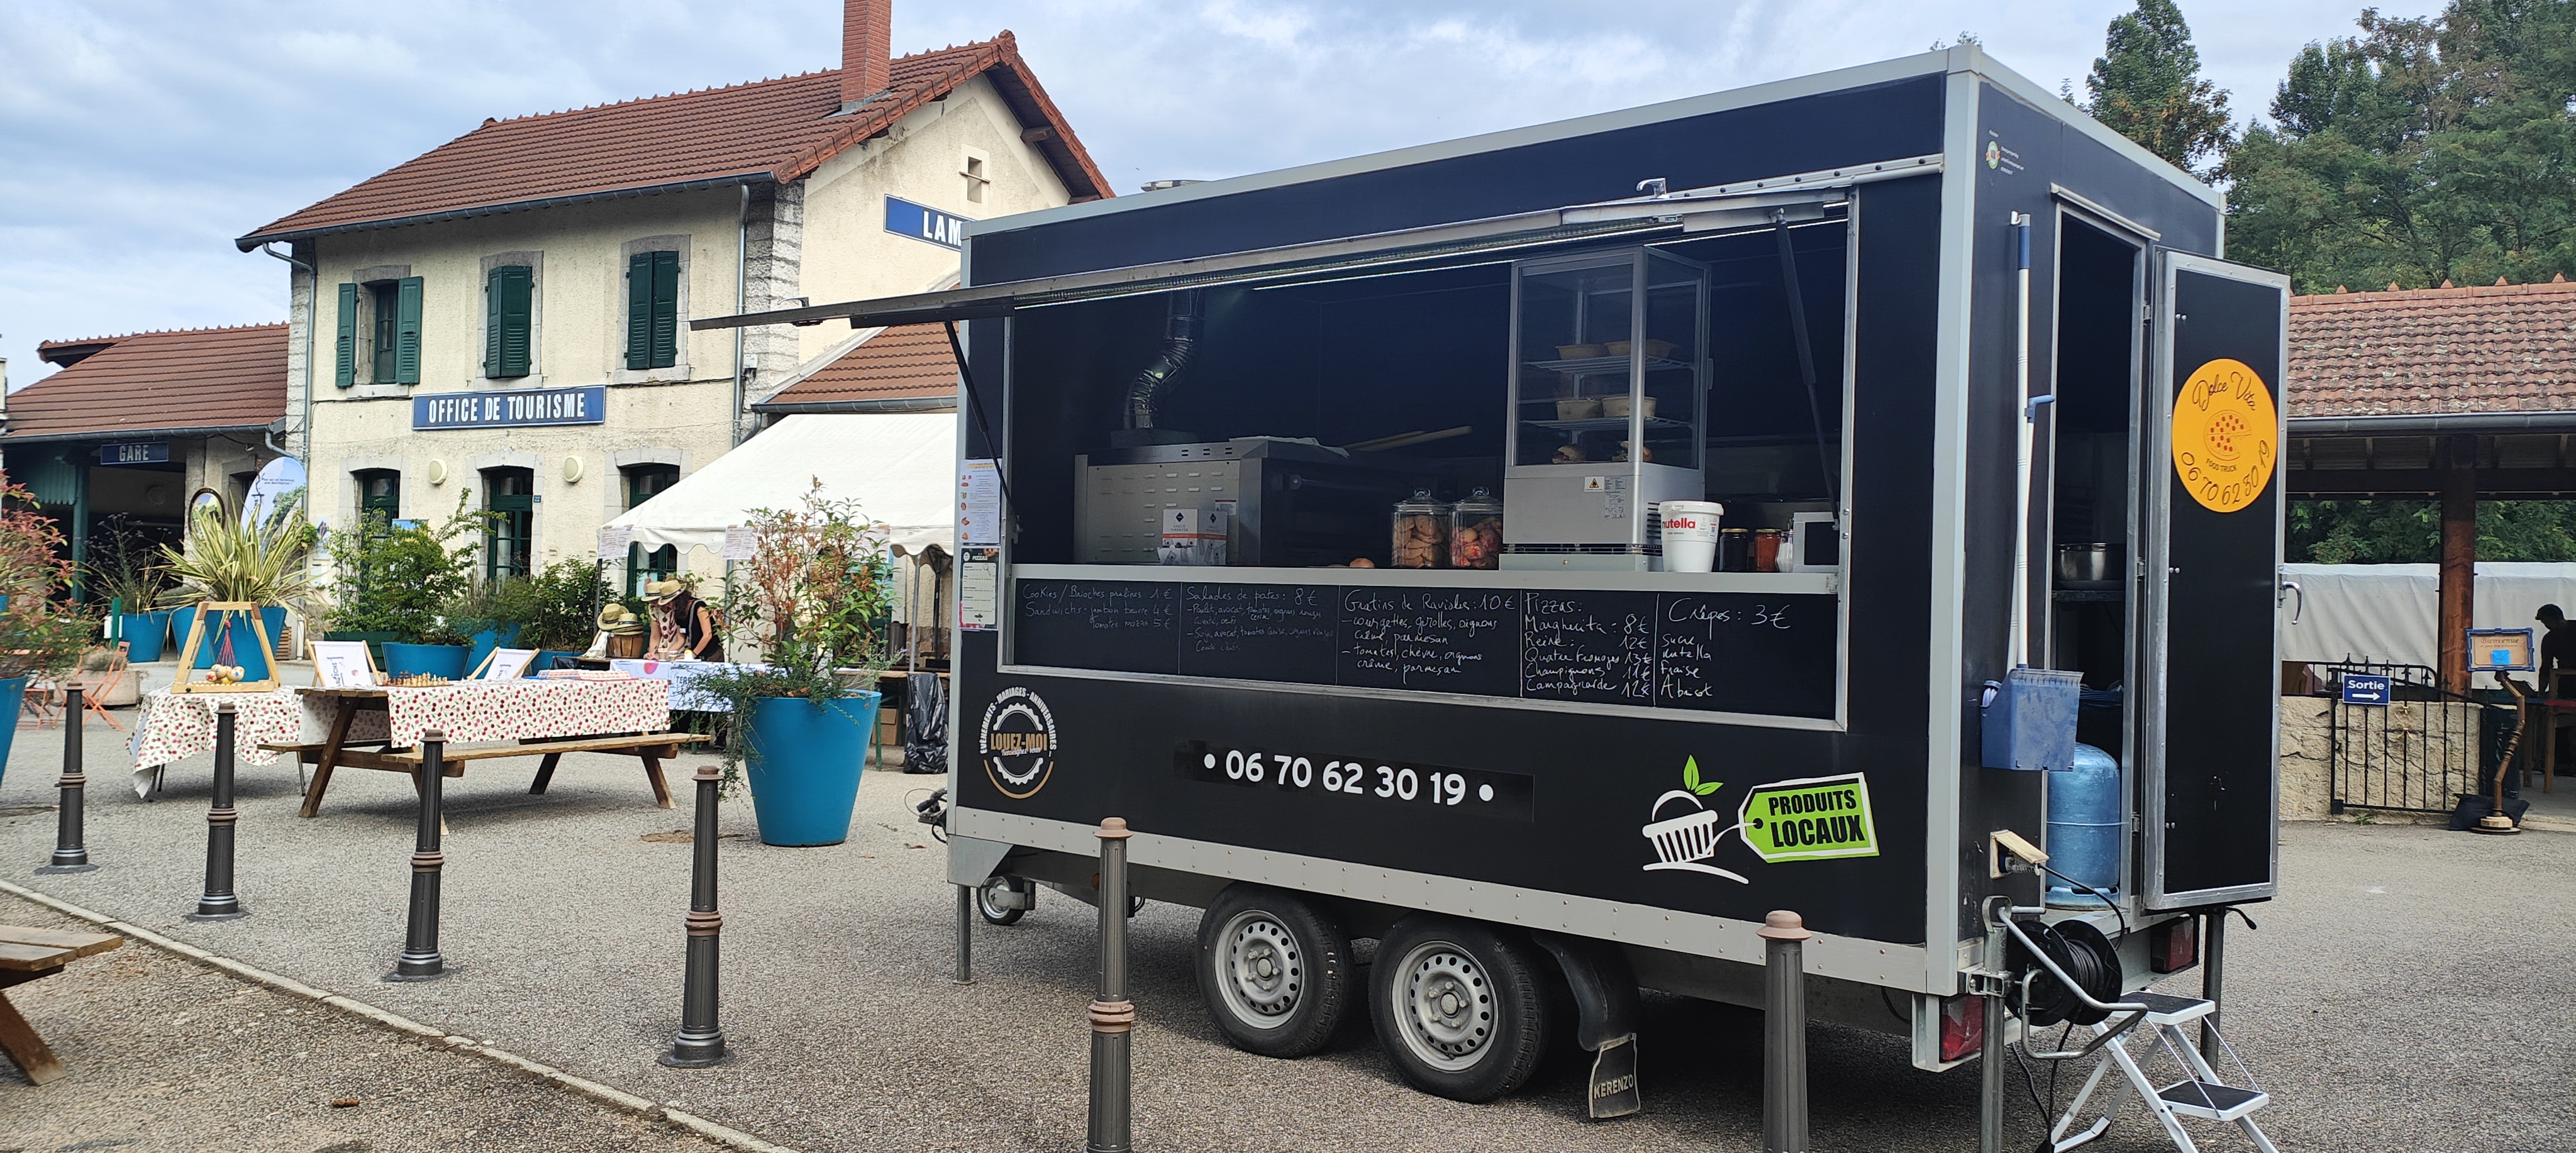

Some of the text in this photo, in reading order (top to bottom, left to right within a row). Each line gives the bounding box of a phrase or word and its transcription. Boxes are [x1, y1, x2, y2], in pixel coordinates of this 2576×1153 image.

[2192, 371, 2256, 412] Dolce Vita
[429, 392, 585, 423] OFFICE DE TOURISME
[119, 444, 148, 461] GARE
[1662, 517, 1696, 529] nutella
[1186, 585, 1231, 600] Salades
[1237, 587, 1248, 599] de
[1402, 593, 1413, 610] de
[1525, 663, 1605, 683] Champignons
[1526, 678, 1617, 695] Campagnarde
[1661, 674, 1713, 698] Abricot
[2348, 680, 2384, 690] Sortie
[991, 733, 1047, 751] LOUEZ-MOI
[1226, 750, 1466, 805] 06 70 62 30 19
[1768, 790, 1857, 816] PRODUITS
[1770, 815, 1865, 848] LOCAUX
[1594, 1074, 1634, 1100] KERENZO
